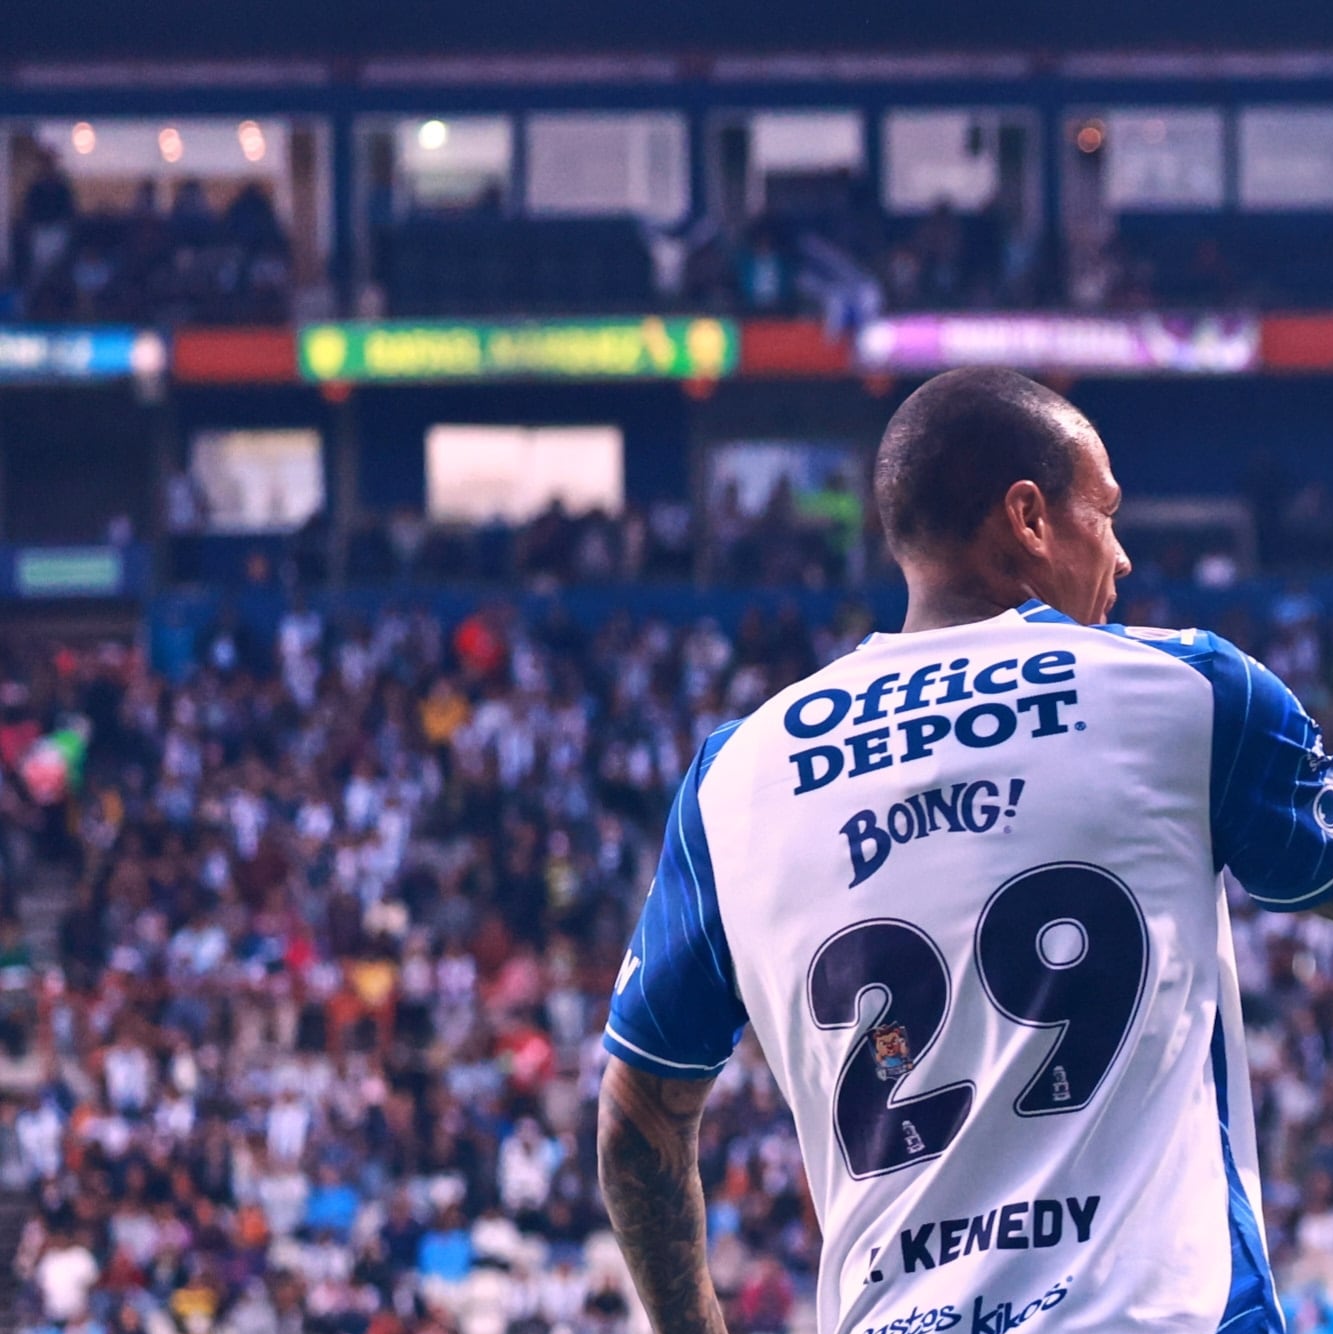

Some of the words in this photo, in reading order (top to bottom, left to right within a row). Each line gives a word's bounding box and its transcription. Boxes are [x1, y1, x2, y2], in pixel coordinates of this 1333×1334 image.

[784, 650, 1077, 739] Office
[789, 690, 1078, 796] DEPOT
[806, 860, 1150, 1182] 29
[900, 1195, 1101, 1274] KENEDY
